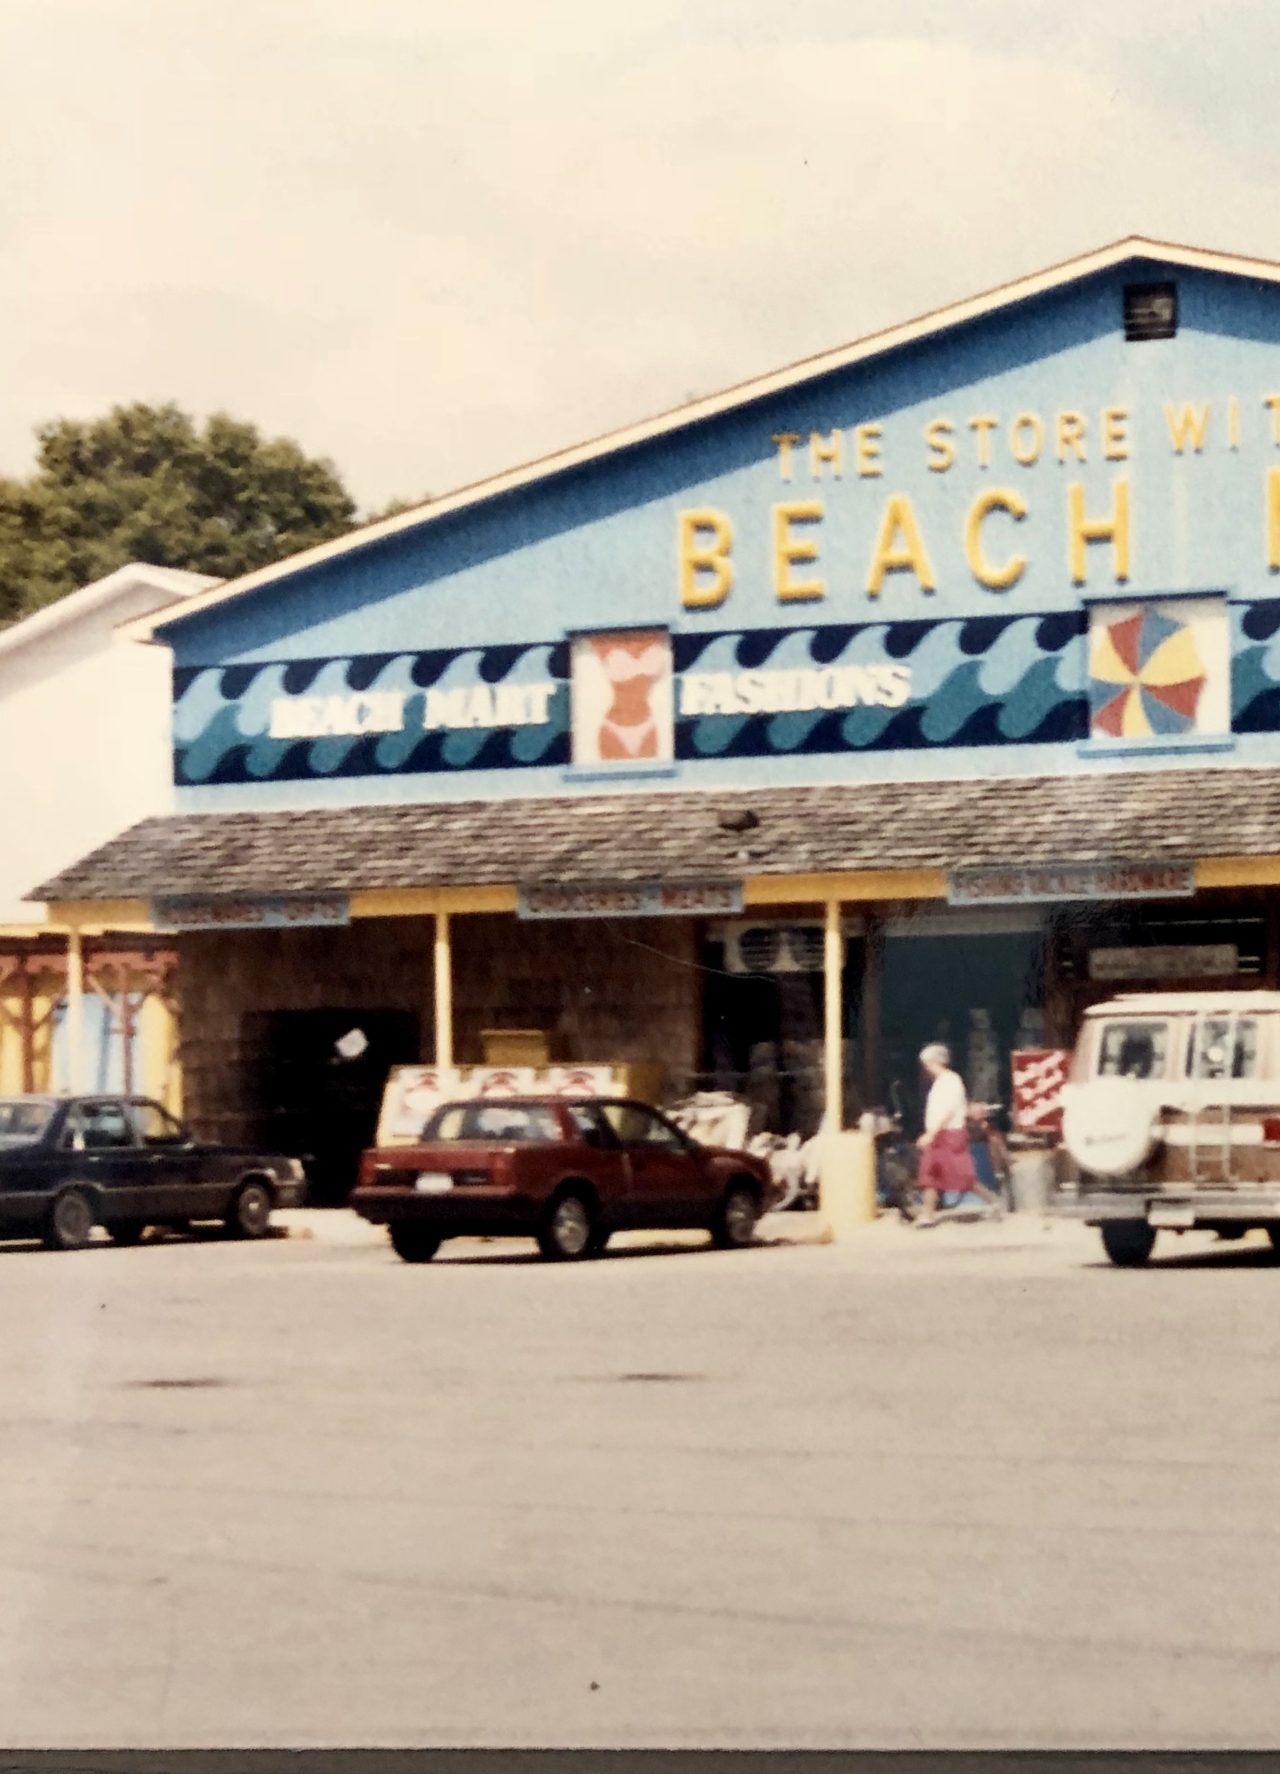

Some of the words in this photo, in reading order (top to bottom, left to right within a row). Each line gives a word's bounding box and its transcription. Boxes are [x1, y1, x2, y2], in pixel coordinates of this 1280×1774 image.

[771, 423, 885, 482] THE
[924, 408, 1130, 473] STORE
[676, 479, 1132, 612] BEACH
[268, 691, 405, 738] BEACH
[423, 682, 555, 730] MART
[679, 664, 912, 716] FASHIONS
